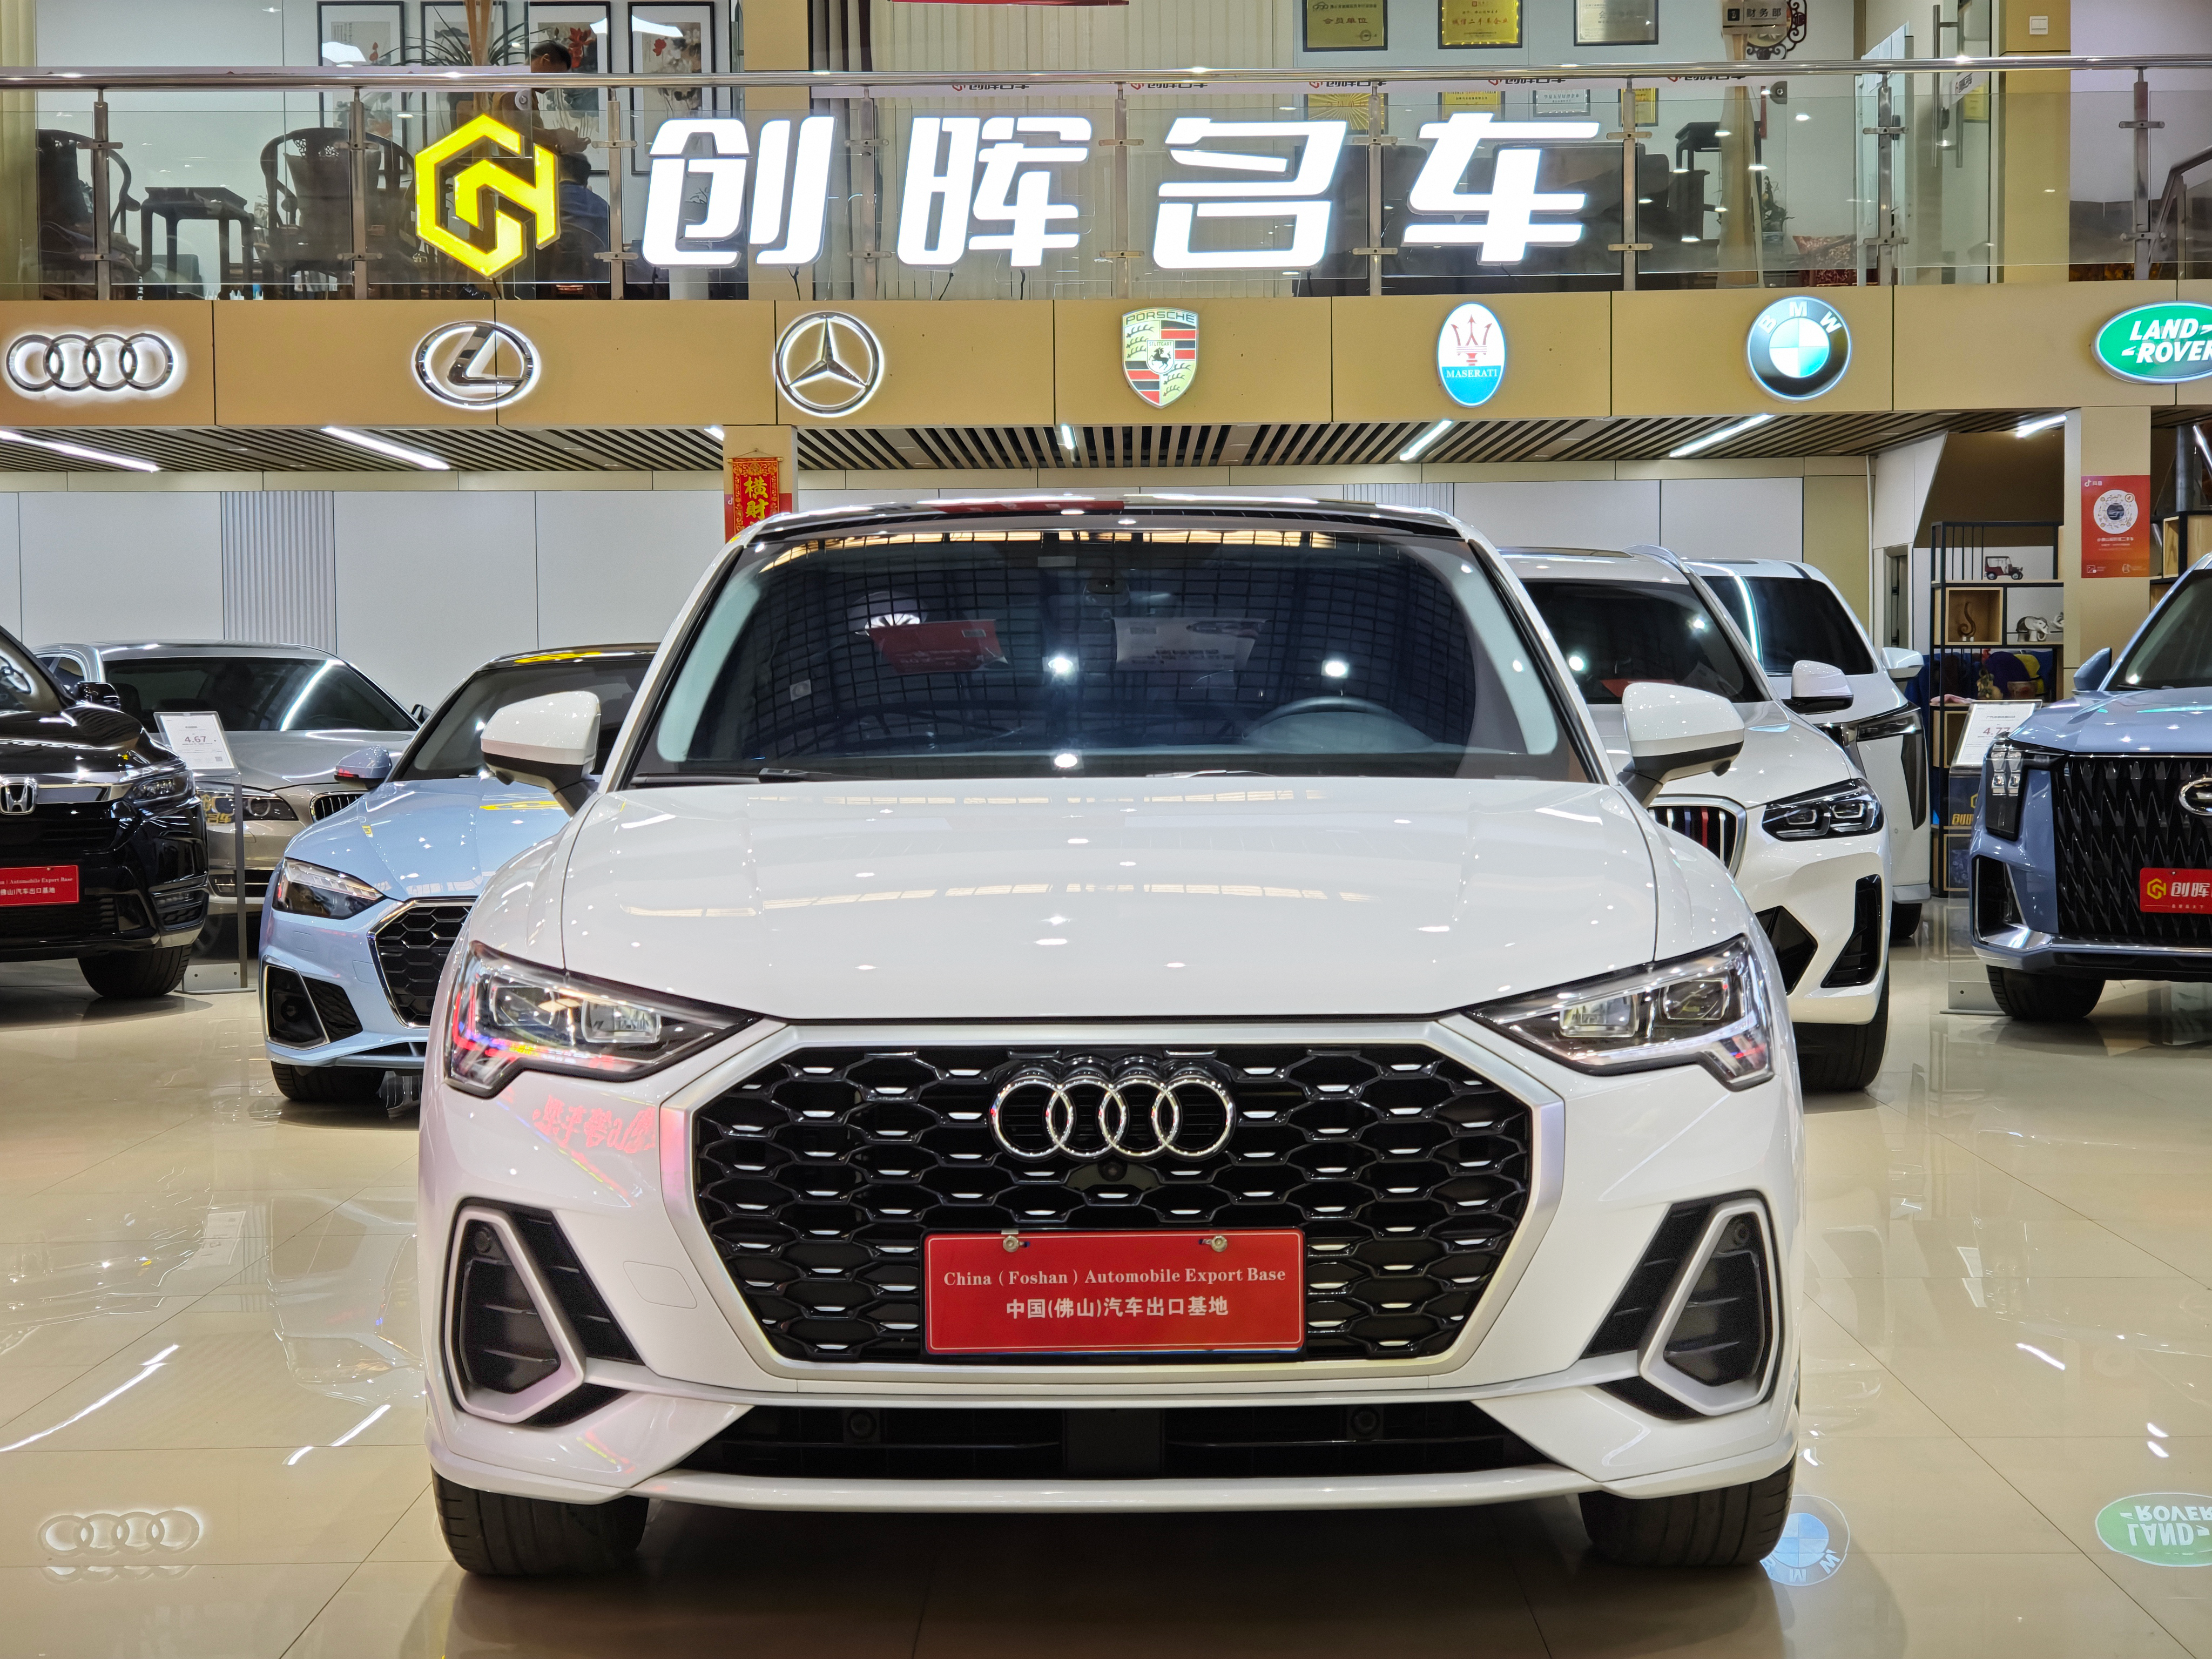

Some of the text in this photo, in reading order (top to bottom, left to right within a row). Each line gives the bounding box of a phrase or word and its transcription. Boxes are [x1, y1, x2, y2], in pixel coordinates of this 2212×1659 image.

[642, 112, 1600, 270] 创晖名车
[1125, 311, 1195, 325] PORSCHE
[1757, 301, 1843, 334] BMW
[2129, 318, 2199, 341] LAND
[2136, 340, 2212, 363] ROVER
[1446, 369, 1498, 378] MASERATI
[2170, 882, 2212, 898] 创晖
[943, 1272, 992, 1286] China
[1084, 1269, 1181, 1284] Automobile
[1185, 1268, 1243, 1285] Export
[1247, 1267, 1286, 1281] Base
[1006, 1296, 1229, 1319] 中国(佛山)汽车出口基地
